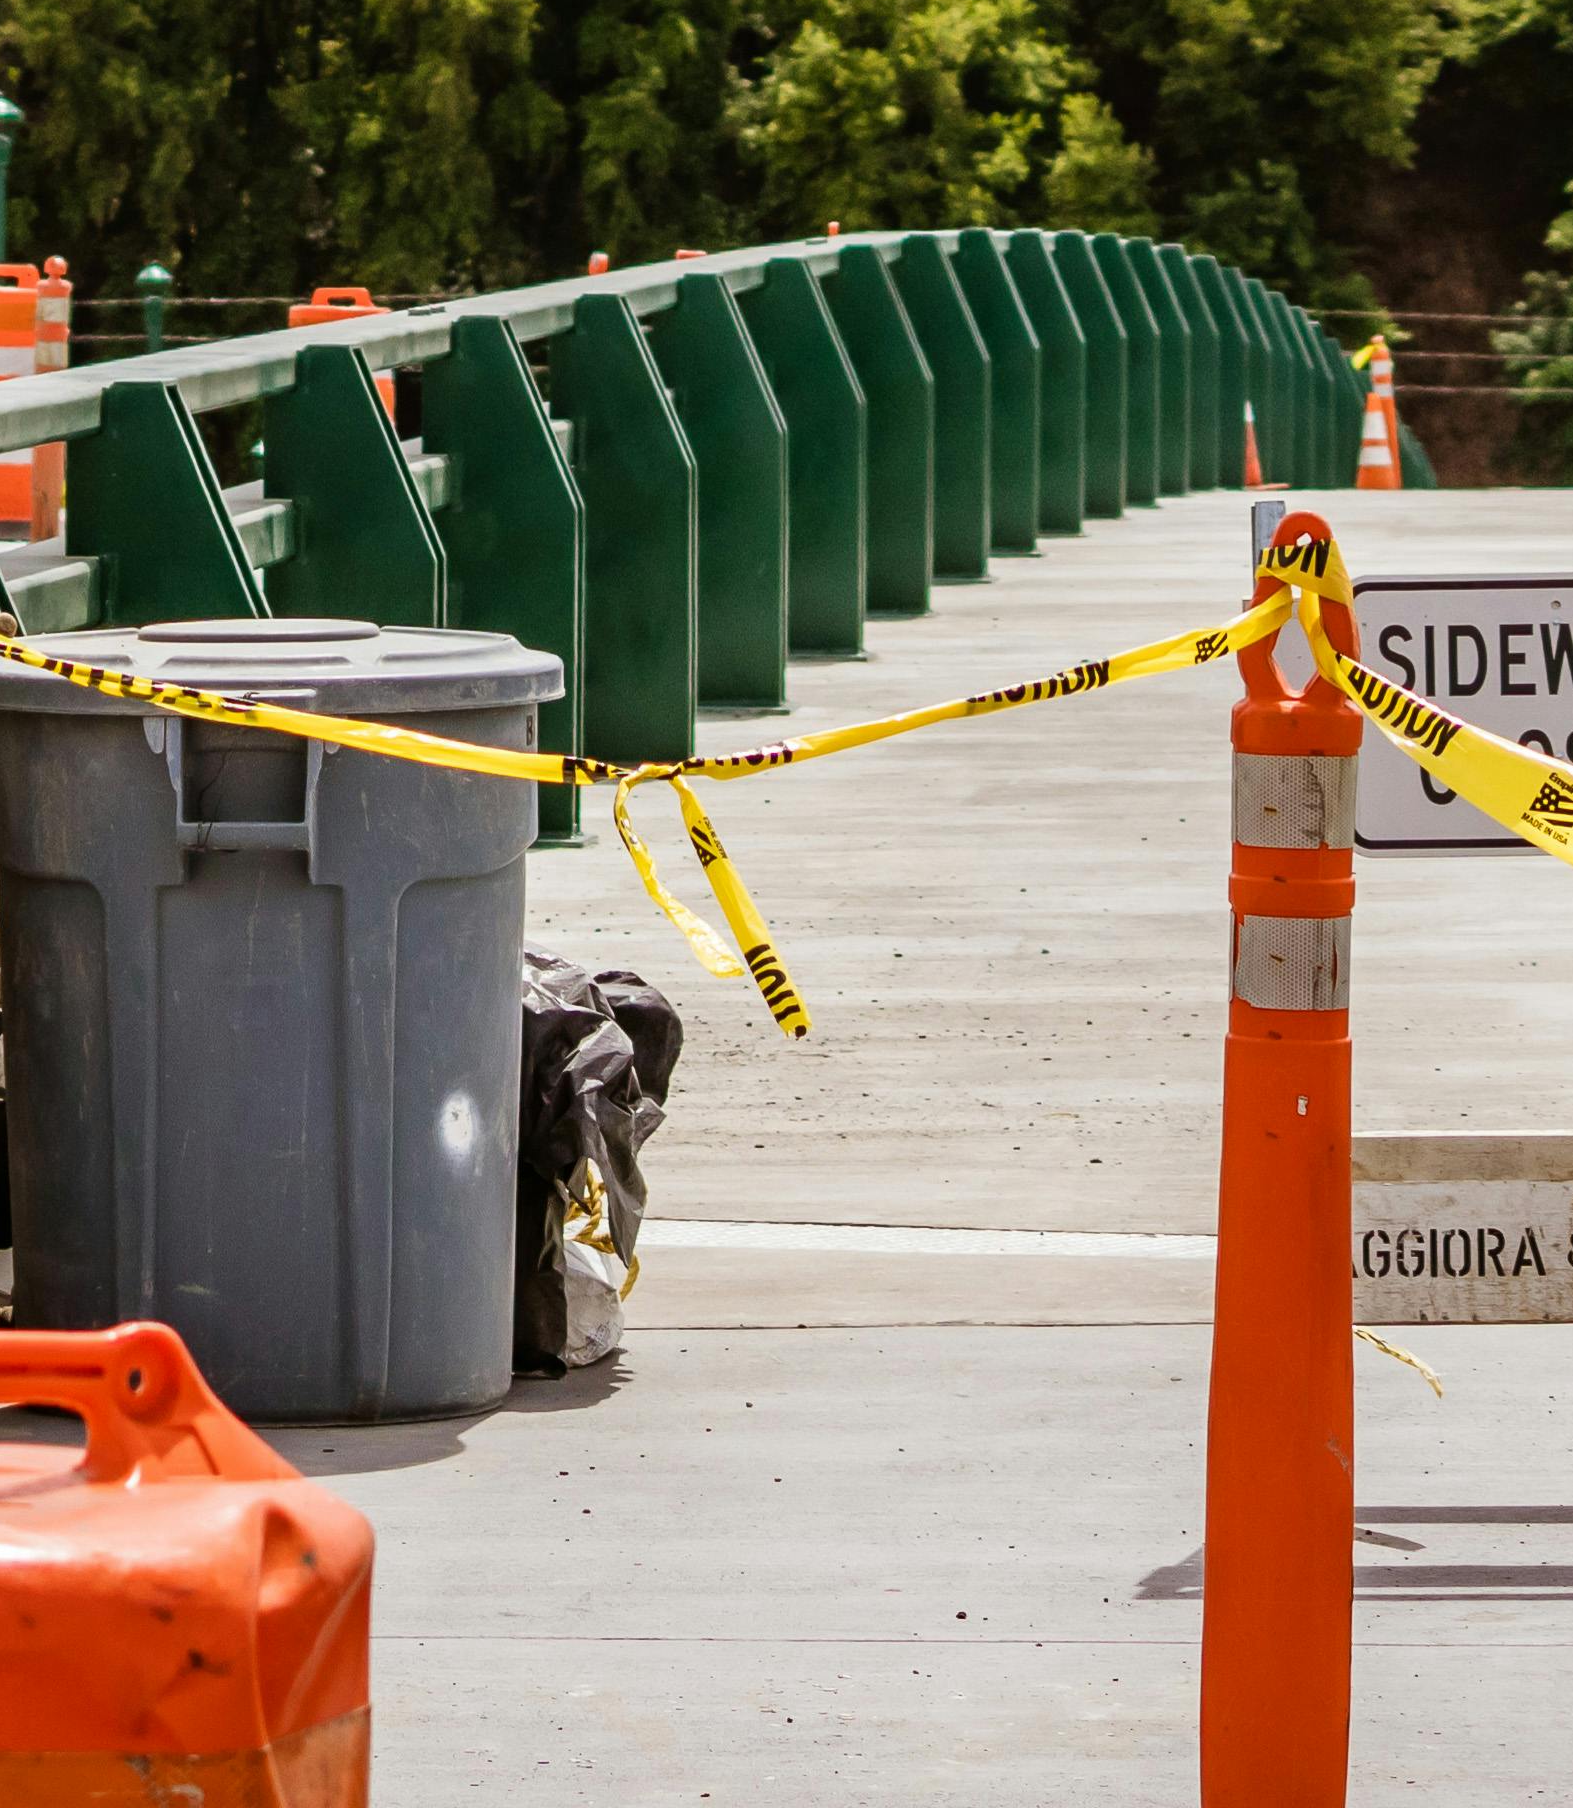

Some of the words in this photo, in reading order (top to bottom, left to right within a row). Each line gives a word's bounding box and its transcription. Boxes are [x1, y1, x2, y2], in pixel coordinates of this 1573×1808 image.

[1335, 651, 1463, 757] AUTION
[1521, 812, 1543, 831] MADE
[1543, 825, 1552, 837] IN
[1553, 831, 1568, 845] USA
[1352, 1228, 1546, 1279] GGIORA
